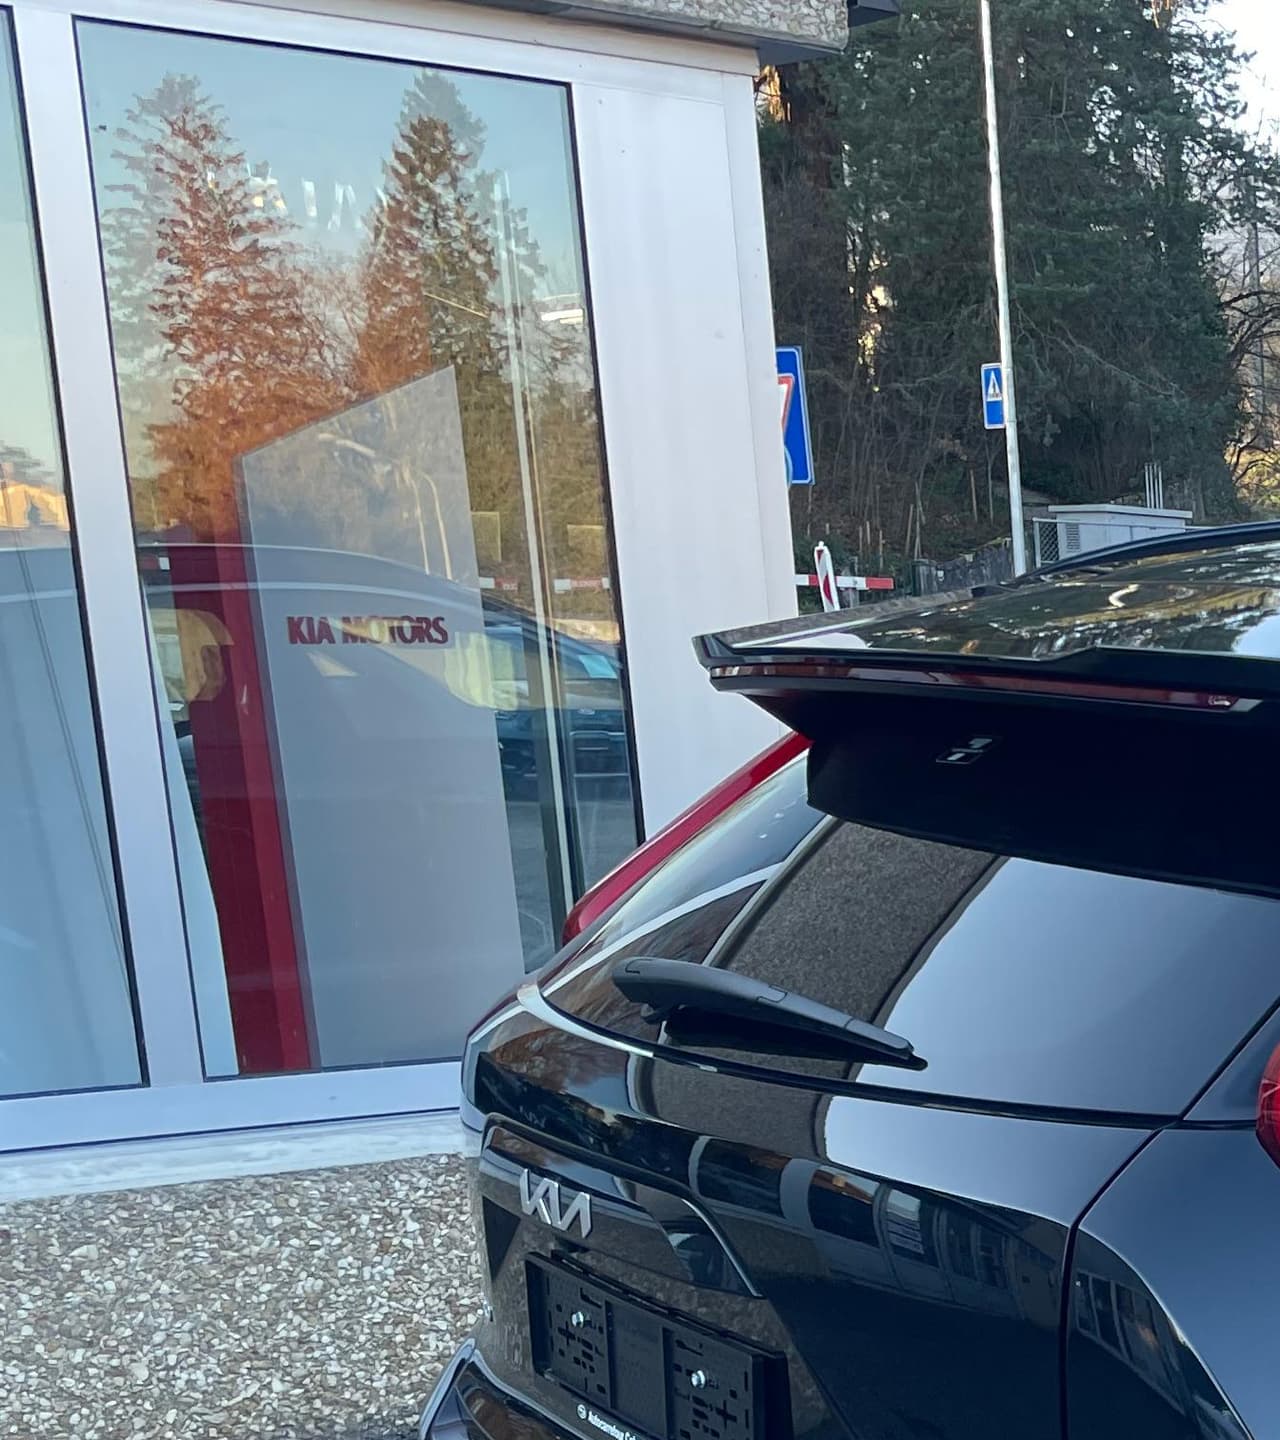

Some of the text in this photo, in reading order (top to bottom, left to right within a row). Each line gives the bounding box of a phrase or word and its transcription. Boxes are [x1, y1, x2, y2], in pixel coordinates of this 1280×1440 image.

[287, 615, 449, 645] KIA MOTORS
[520, 1168, 592, 1239] KIA
